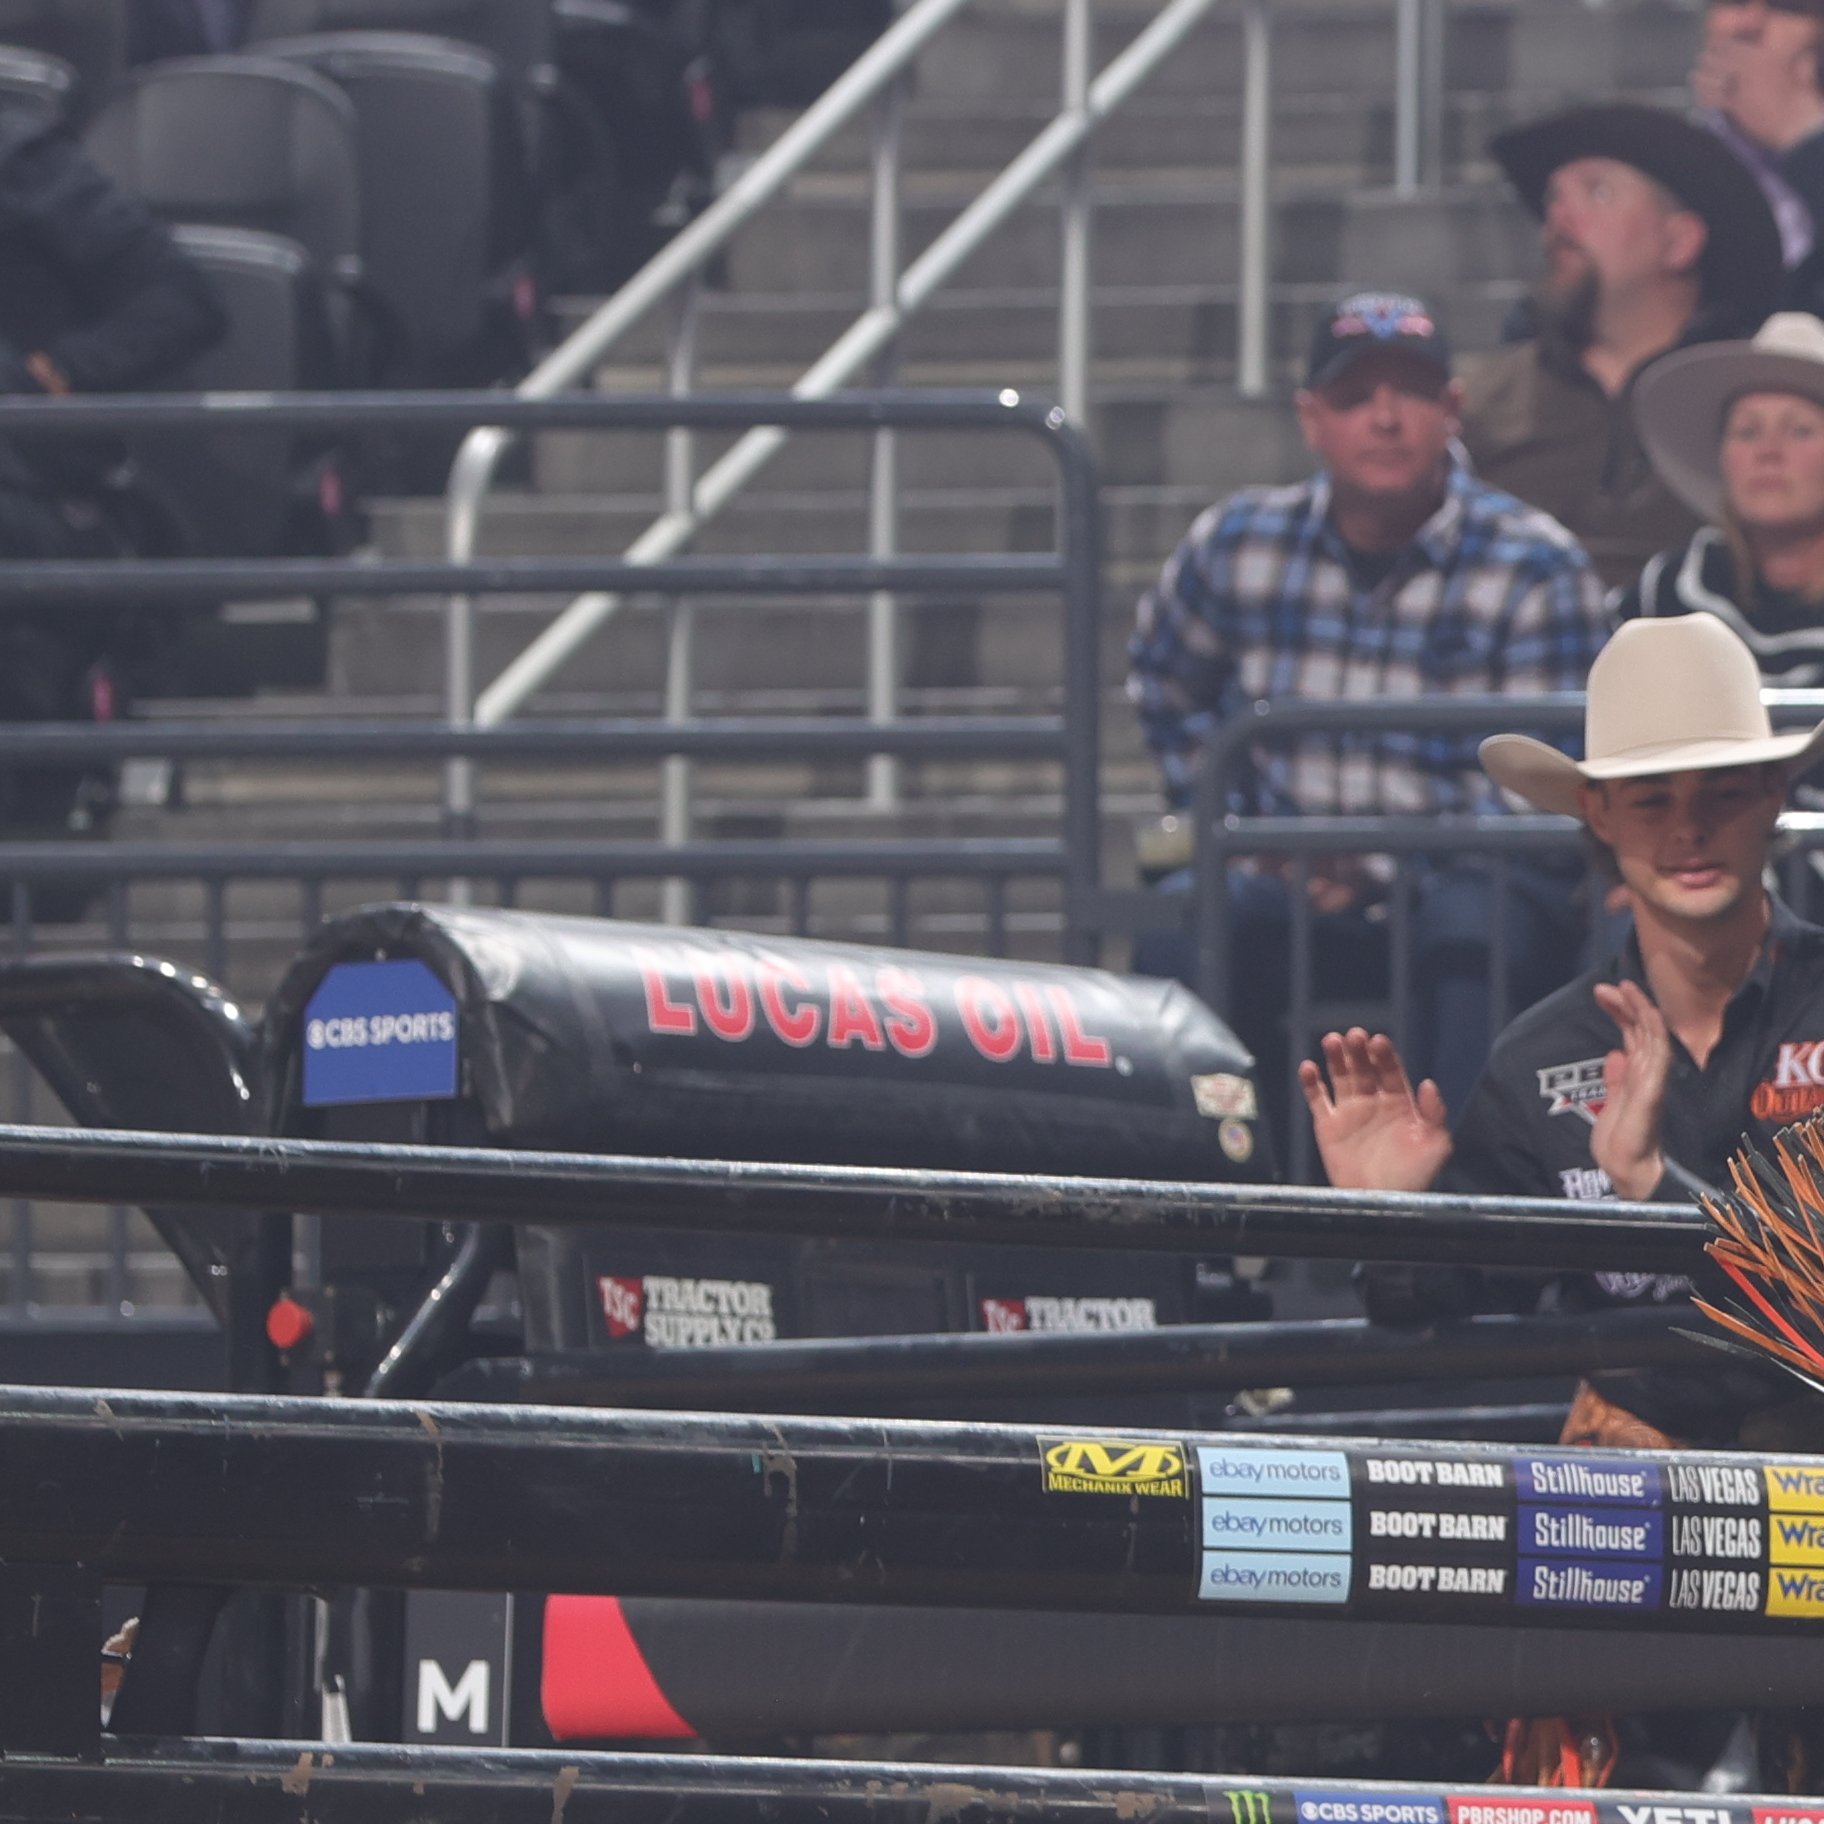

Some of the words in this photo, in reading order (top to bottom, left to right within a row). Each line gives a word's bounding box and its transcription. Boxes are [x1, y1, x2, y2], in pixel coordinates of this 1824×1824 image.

[634, 947, 936, 1059] LUCAS
[954, 974, 1111, 1068] OIL
[325, 1016, 368, 1048] CBS
[370, 1011, 455, 1045] SPORTS
[642, 1275, 772, 1318] TRACTOR
[1025, 1296, 1156, 1331] TRACTOR
[645, 1311, 742, 1348] SUPPLY
[1047, 1473, 1133, 1495] MECHANIX
[1135, 1480, 1183, 1498] WEAR
[1367, 1459, 1433, 1484] BOOT
[1437, 1461, 1504, 1489] BARN
[1532, 1461, 1645, 1498] Stillhouse
[1370, 1511, 1436, 1538] BOOT
[1440, 1514, 1506, 1541] BARN
[1535, 1513, 1647, 1552] Stillhouse
[1368, 1564, 1435, 1591] BOOT
[1437, 1566, 1505, 1594] BARN
[1533, 1566, 1645, 1604] Stillhouse
[1318, 1803, 1358, 1822] CBS
[1360, 1804, 1438, 1824] SPORTS
